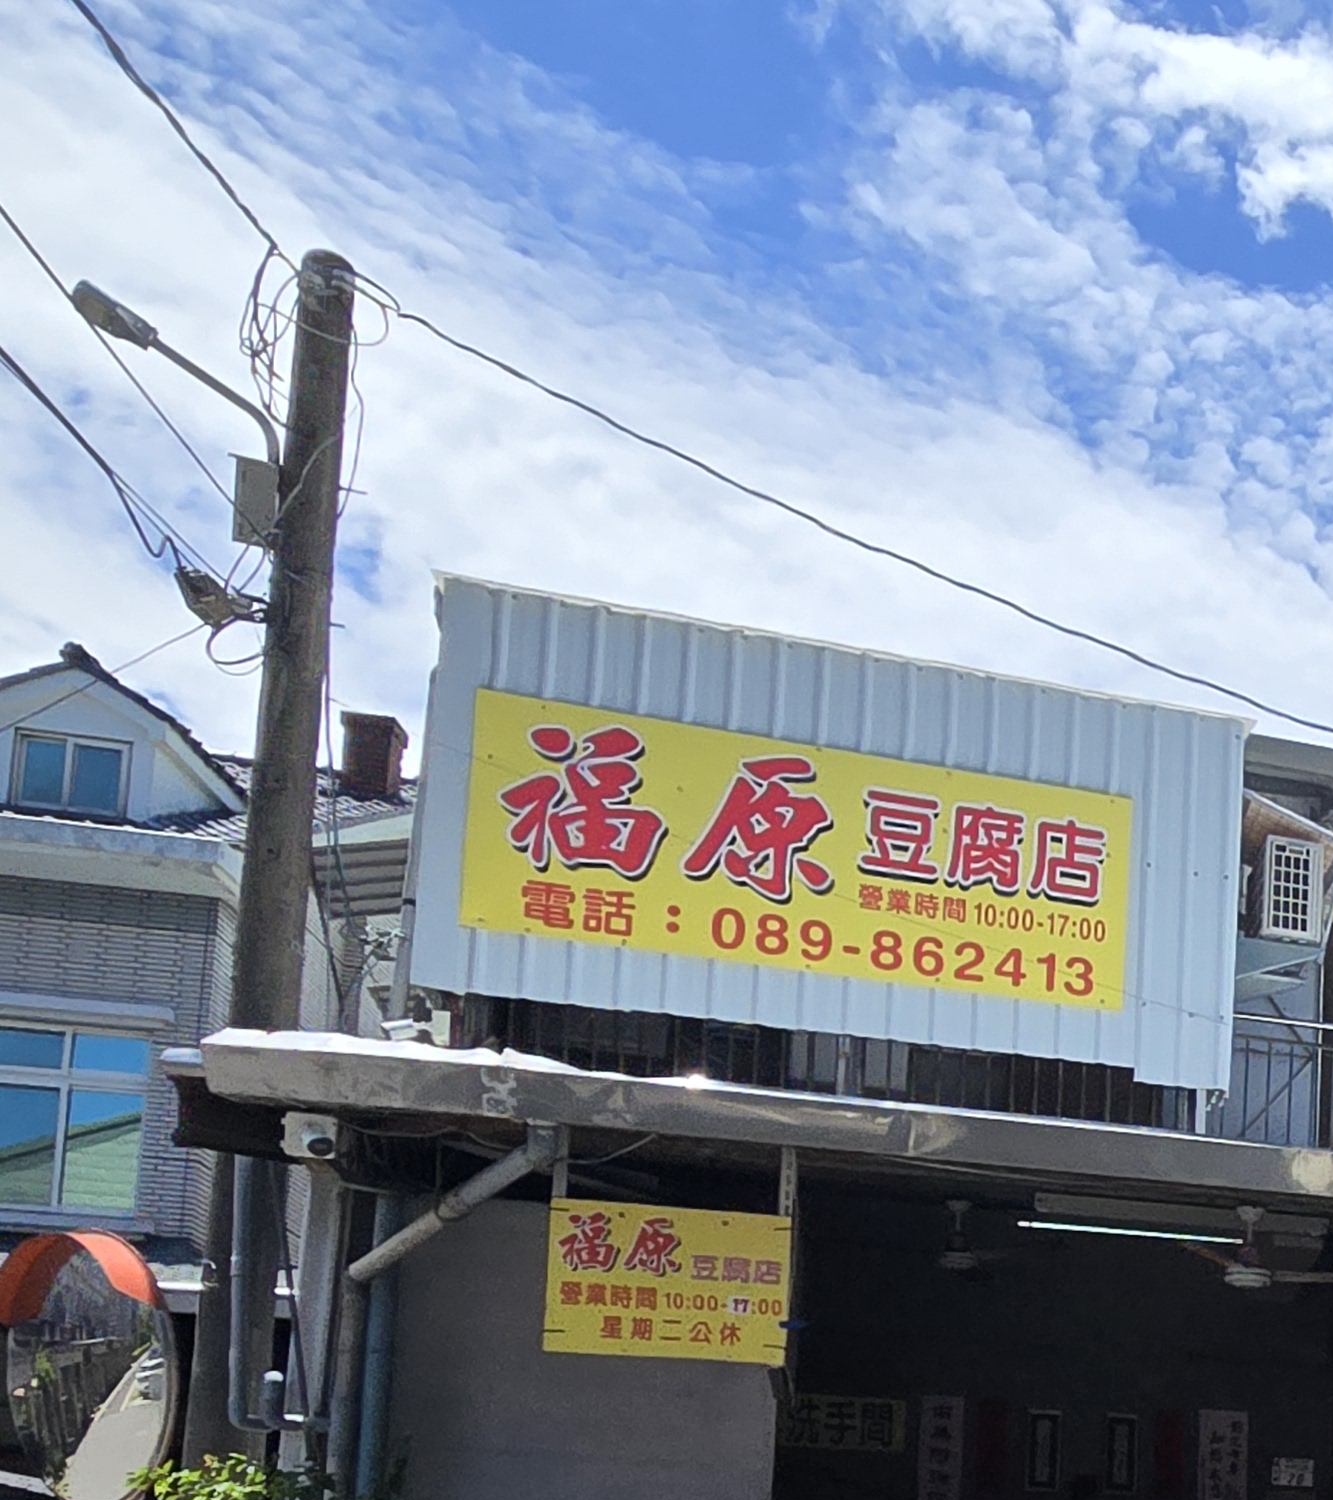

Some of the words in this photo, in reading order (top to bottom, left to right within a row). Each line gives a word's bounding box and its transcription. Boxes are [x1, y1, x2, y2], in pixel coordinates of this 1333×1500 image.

[857, 787, 1105, 905] 豆腐店
[858, 884, 967, 924] 營業時間
[973, 903, 1105, 942] 10:00-17:00
[711, 907, 1096, 997] 089-862413
[691, 1255, 782, 1285] 豆腐店
[560, 1281, 657, 1311] 營業時間
[600, 1316, 741, 1346] 星期二公休
